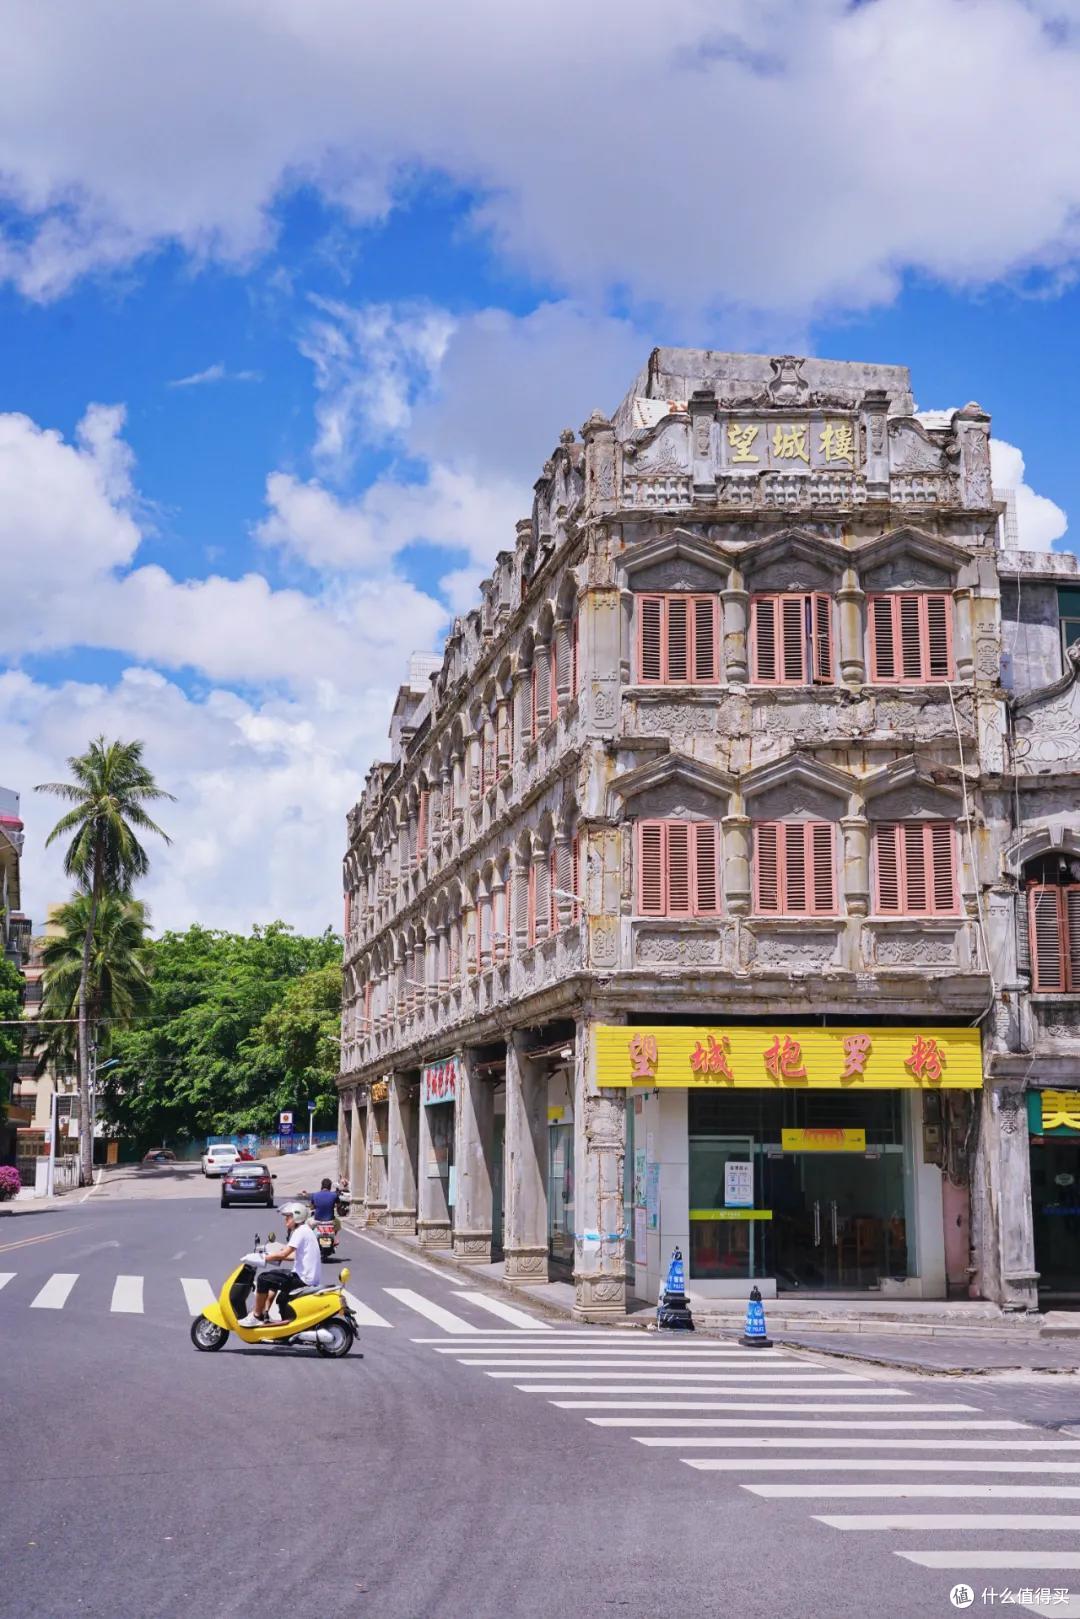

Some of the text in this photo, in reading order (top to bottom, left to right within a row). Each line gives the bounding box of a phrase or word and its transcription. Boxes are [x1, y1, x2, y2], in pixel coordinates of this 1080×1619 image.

[727, 423, 857, 465] 望城樓
[628, 1033, 946, 1080] 望城抱罗粉
